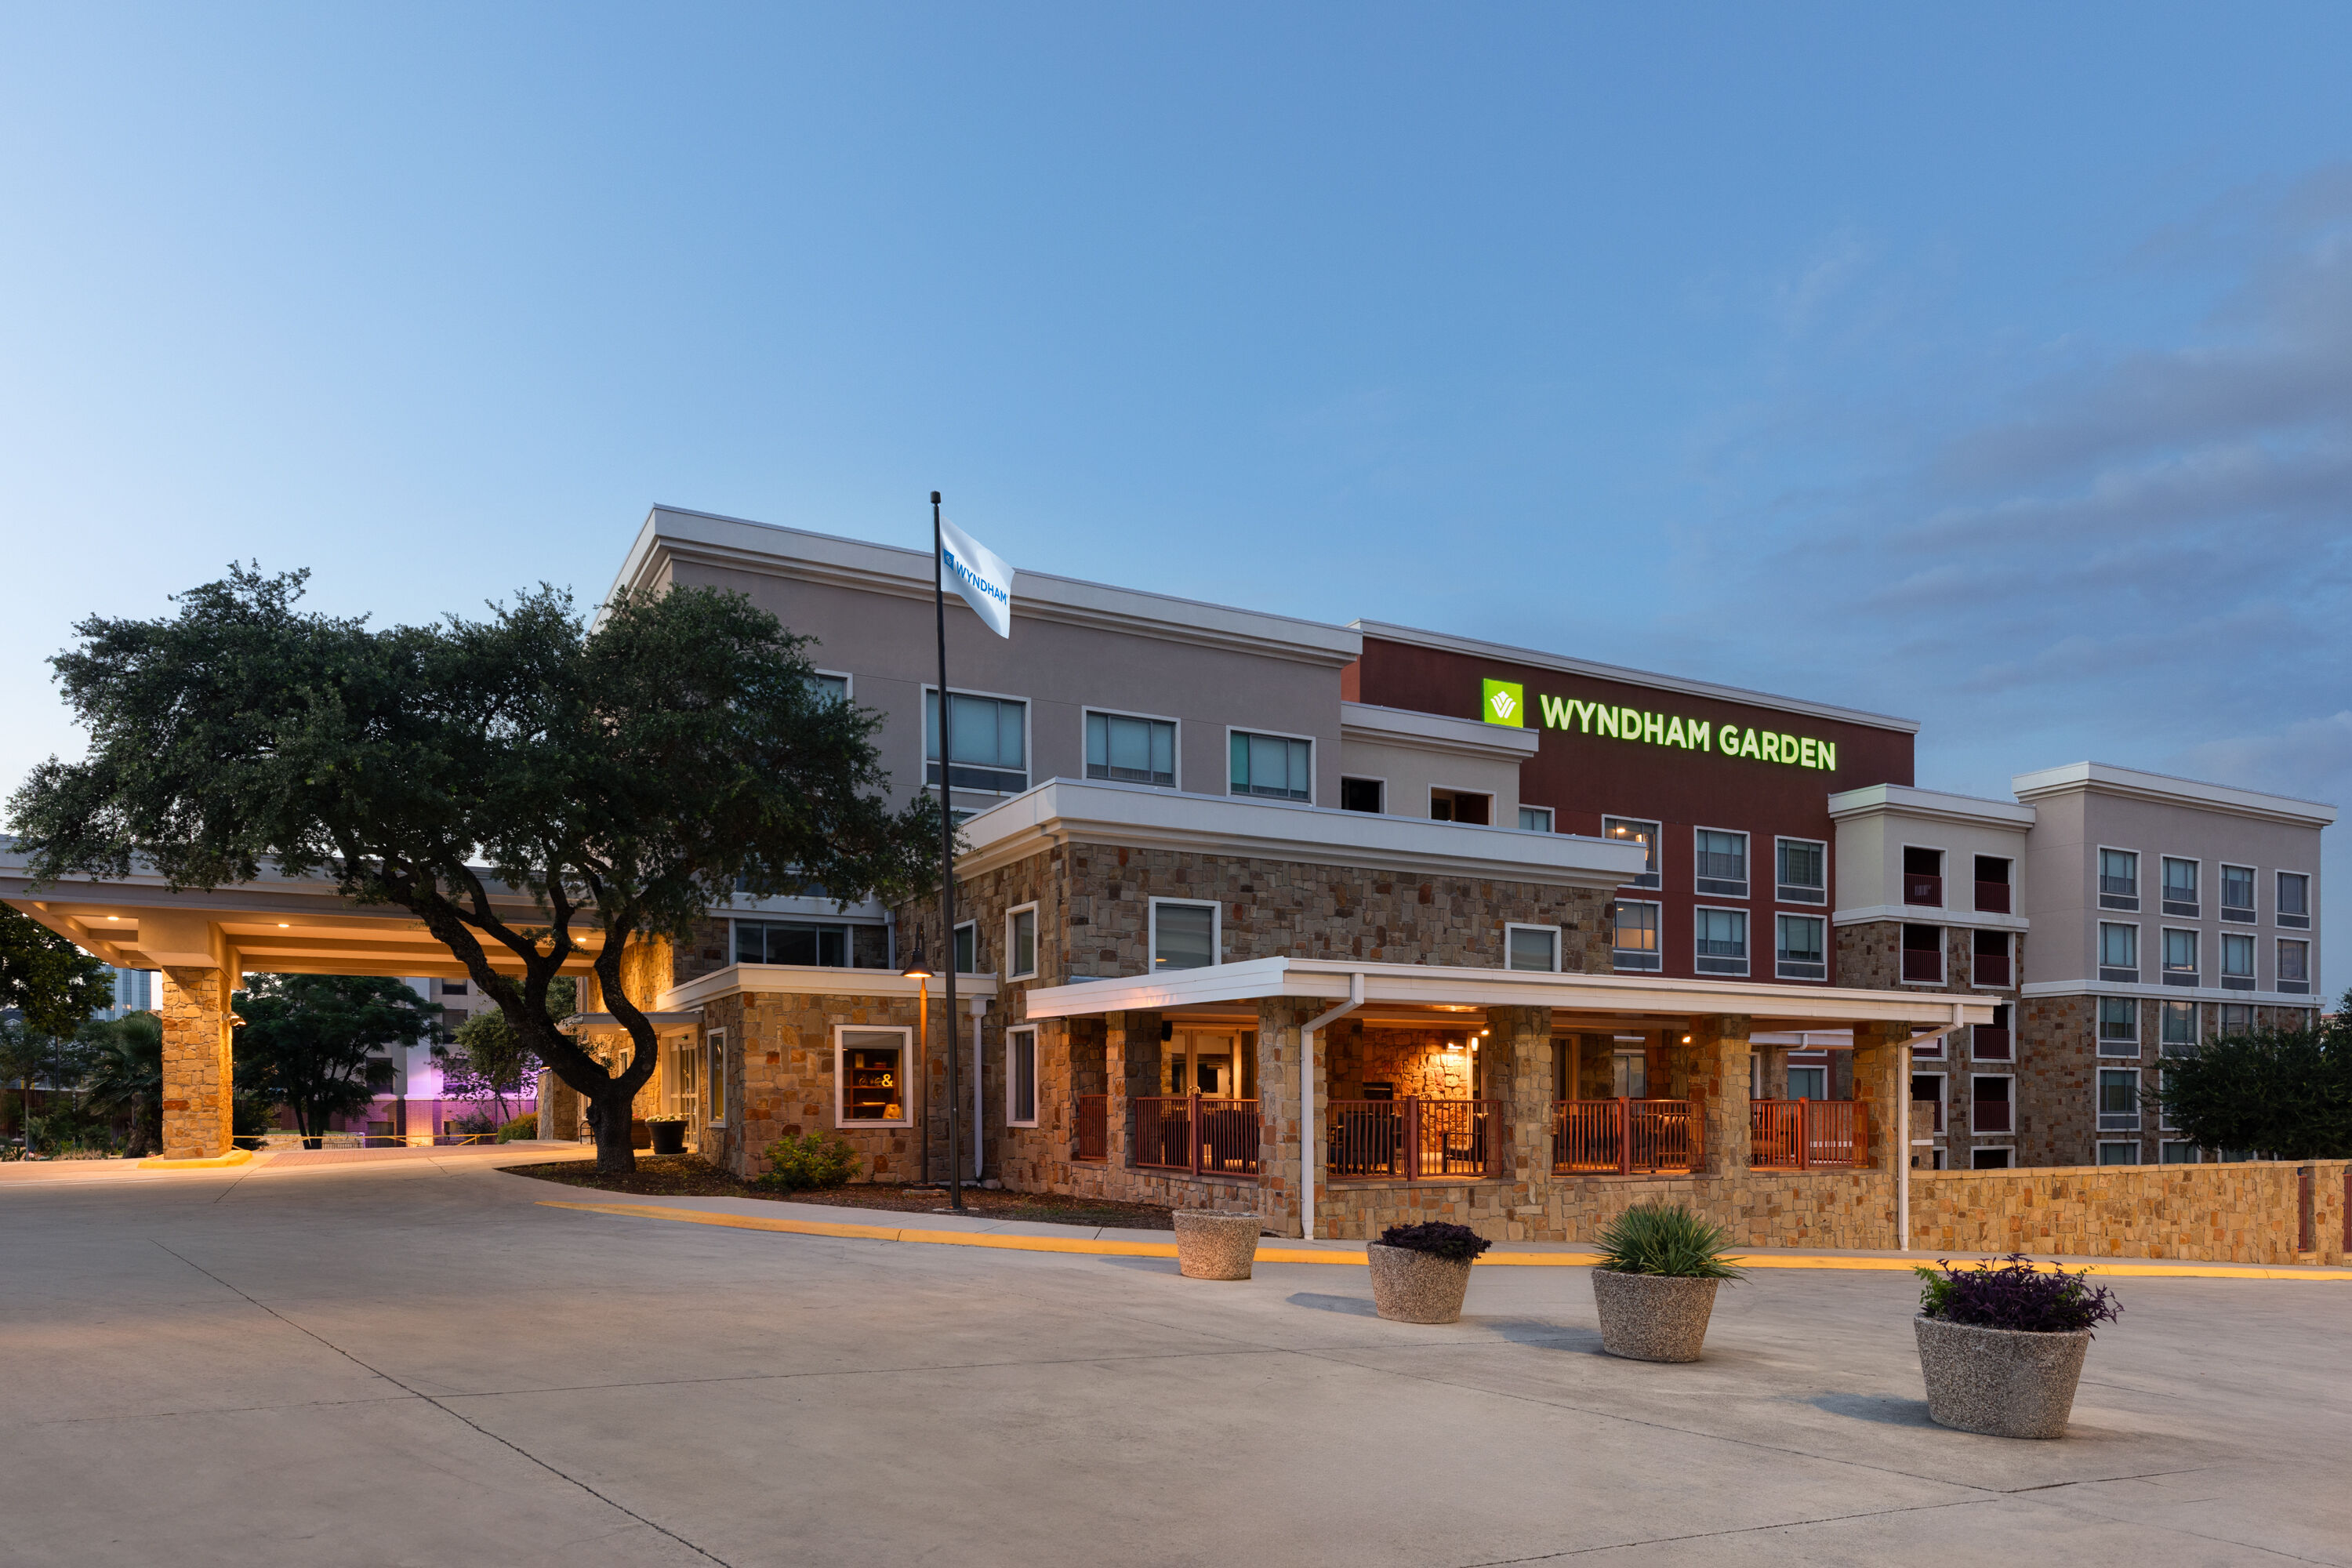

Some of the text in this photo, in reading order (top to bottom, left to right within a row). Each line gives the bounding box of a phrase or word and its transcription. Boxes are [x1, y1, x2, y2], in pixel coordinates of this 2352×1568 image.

[956, 561, 1007, 605] WYNDHAM
[1539, 694, 1837, 771] WYNDHAM GARDEN
